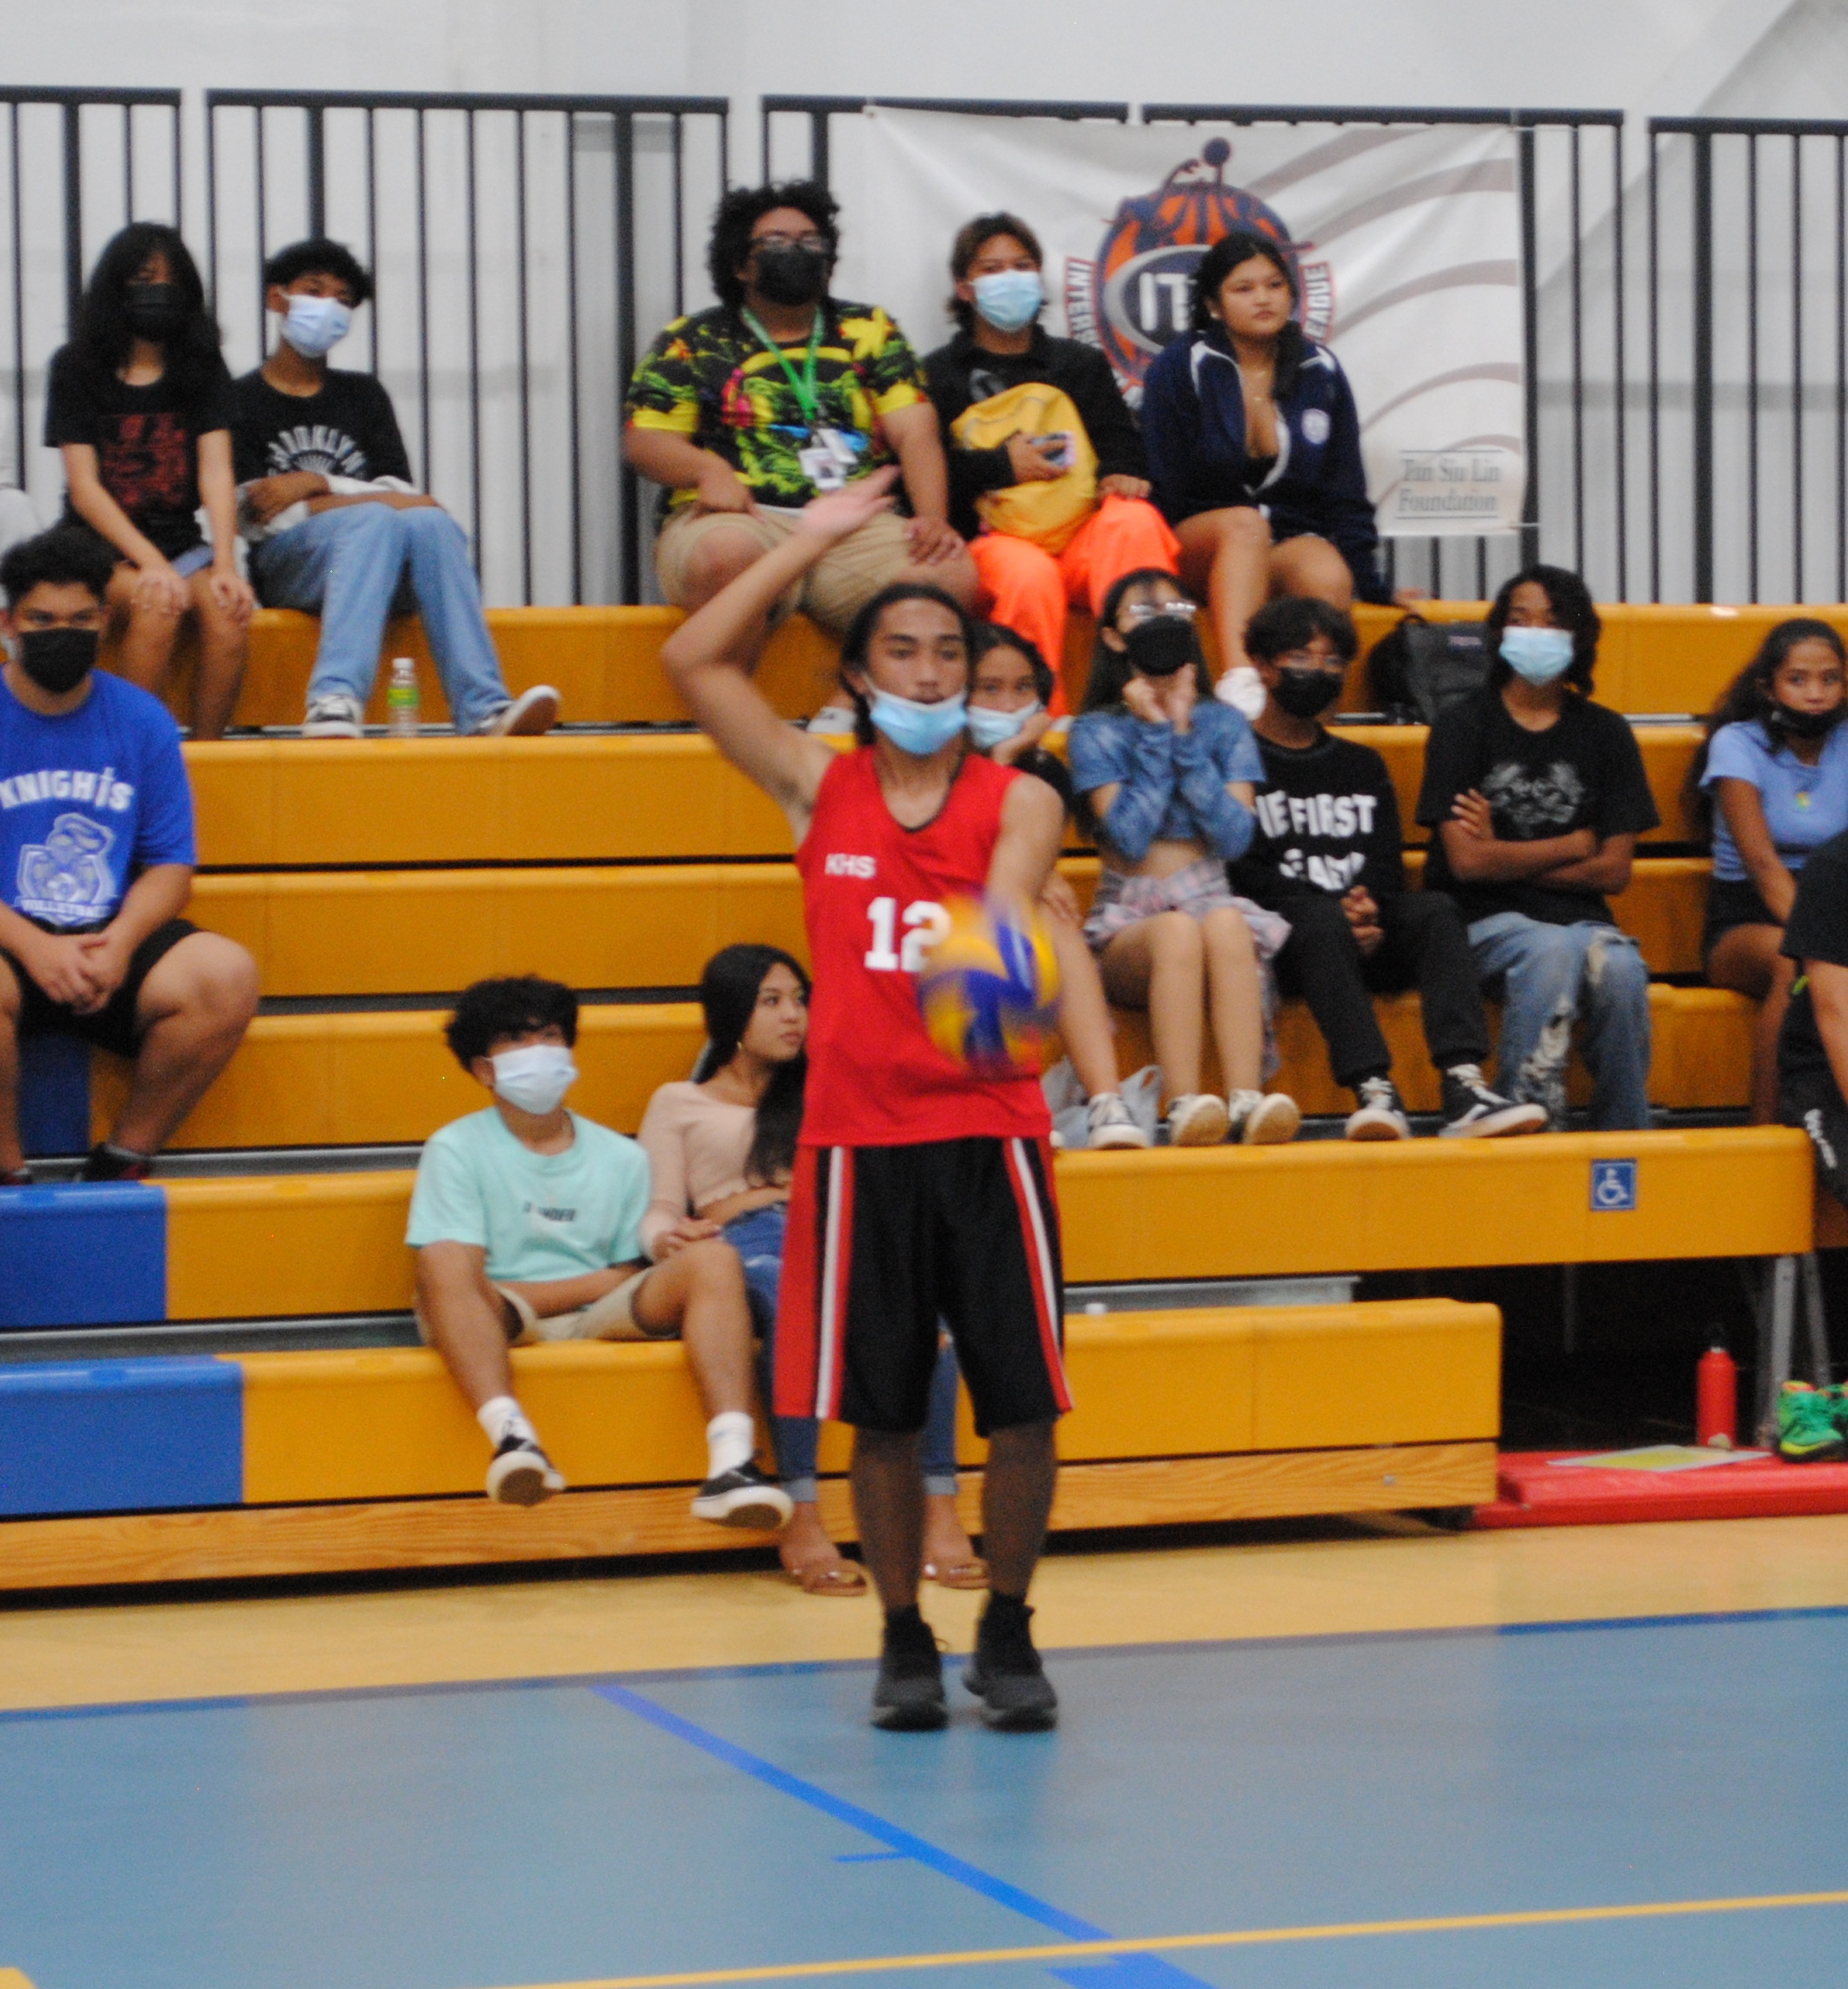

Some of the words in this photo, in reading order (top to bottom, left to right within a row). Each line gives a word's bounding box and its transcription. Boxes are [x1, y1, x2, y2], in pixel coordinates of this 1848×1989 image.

[1303, 265, 1332, 342] EAGUE
[1401, 459, 1433, 482] Tan
[1471, 458, 1502, 482] Lin
[1397, 488, 1497, 512] Foundation
[0, 767, 135, 810] KNIGHTS
[825, 853, 877, 879] KHS
[865, 896, 951, 972] 12
